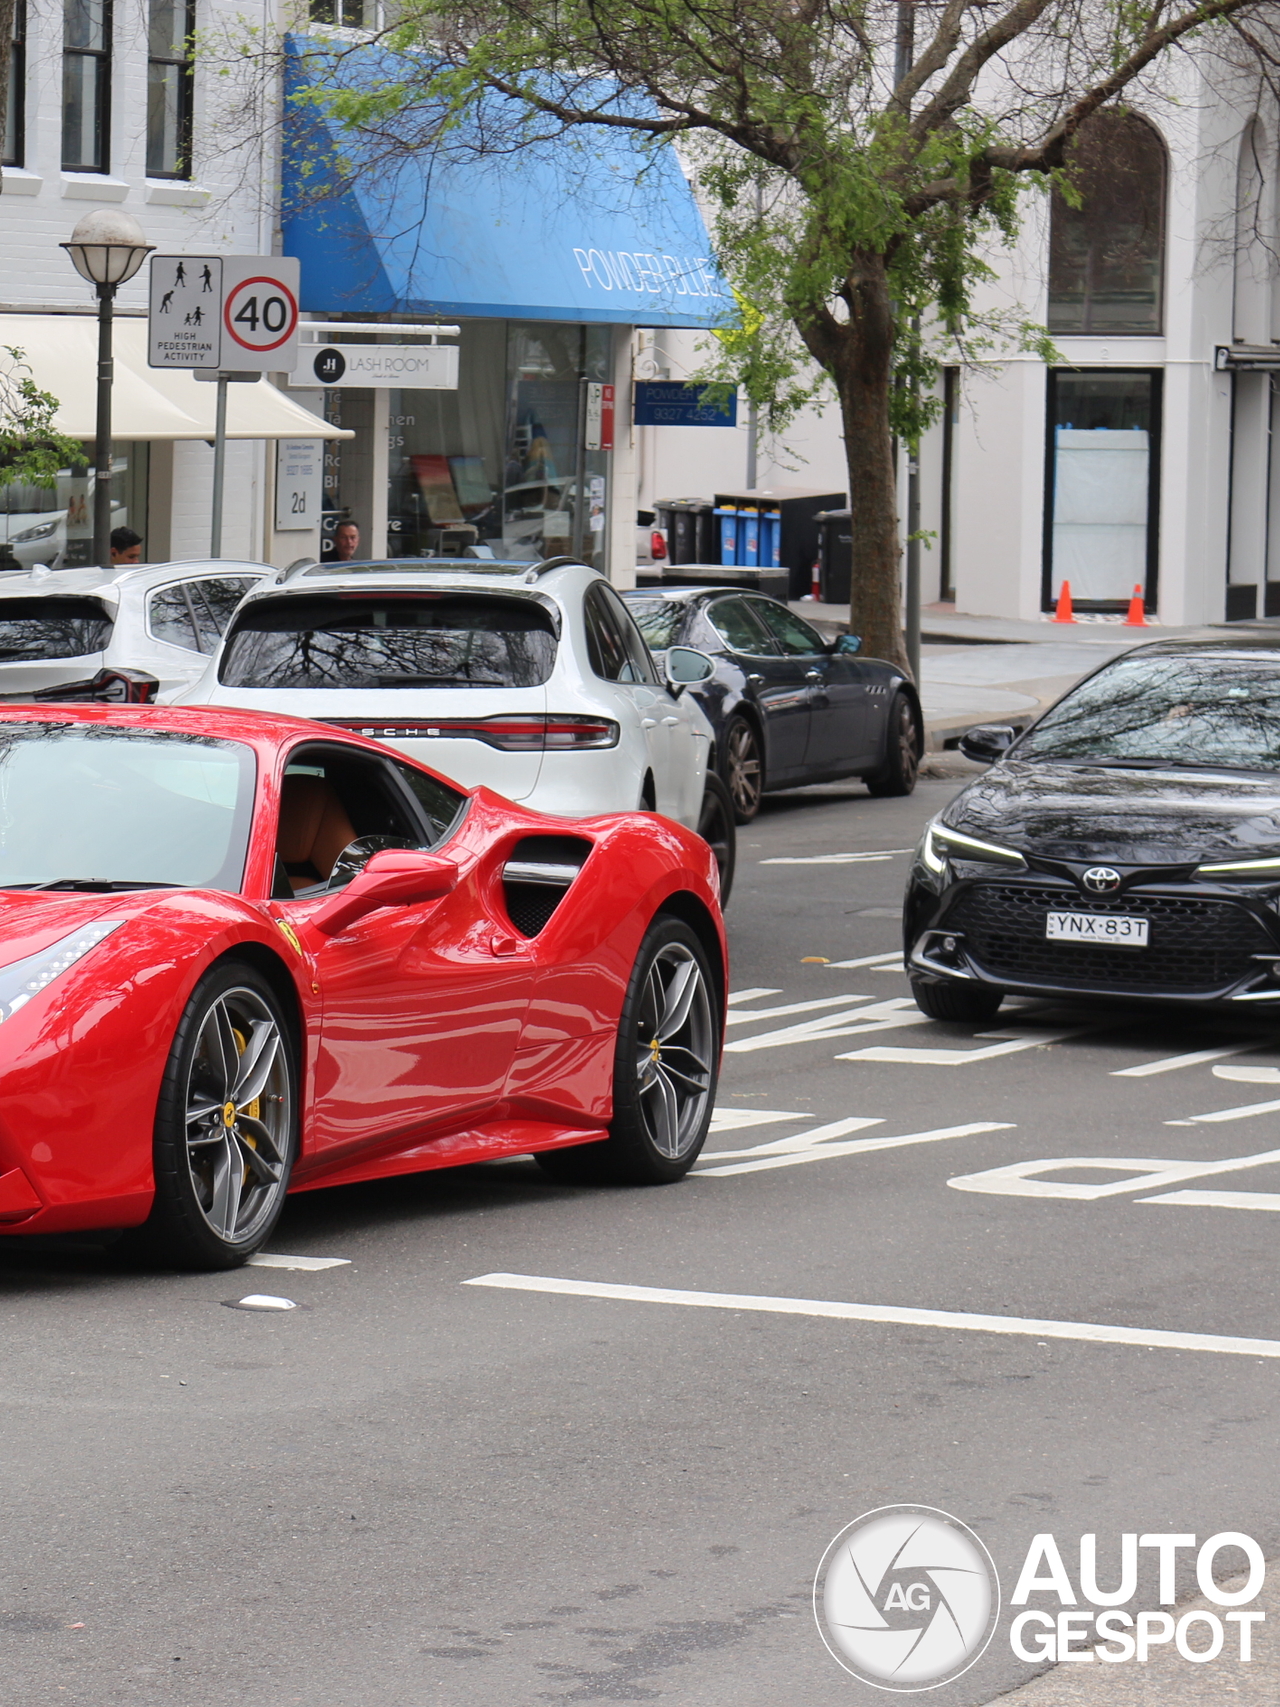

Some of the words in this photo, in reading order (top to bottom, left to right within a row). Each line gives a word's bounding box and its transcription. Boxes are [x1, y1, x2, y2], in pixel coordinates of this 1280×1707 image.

[573, 248, 662, 293] POWDER
[662, 255, 722, 297] BLUE
[234, 296, 287, 332] 40
[174, 332, 196, 341] HIGH
[158, 342, 212, 351] PEDESTRIAN
[164, 352, 205, 361] ACTIVITY
[350, 358, 382, 371] LASH
[385, 358, 429, 372] ROOM
[646, 388, 694, 400] POWDER
[654, 408, 683, 420] 9327
[686, 408, 716, 421] 4252
[291, 491, 307, 514] 2d
